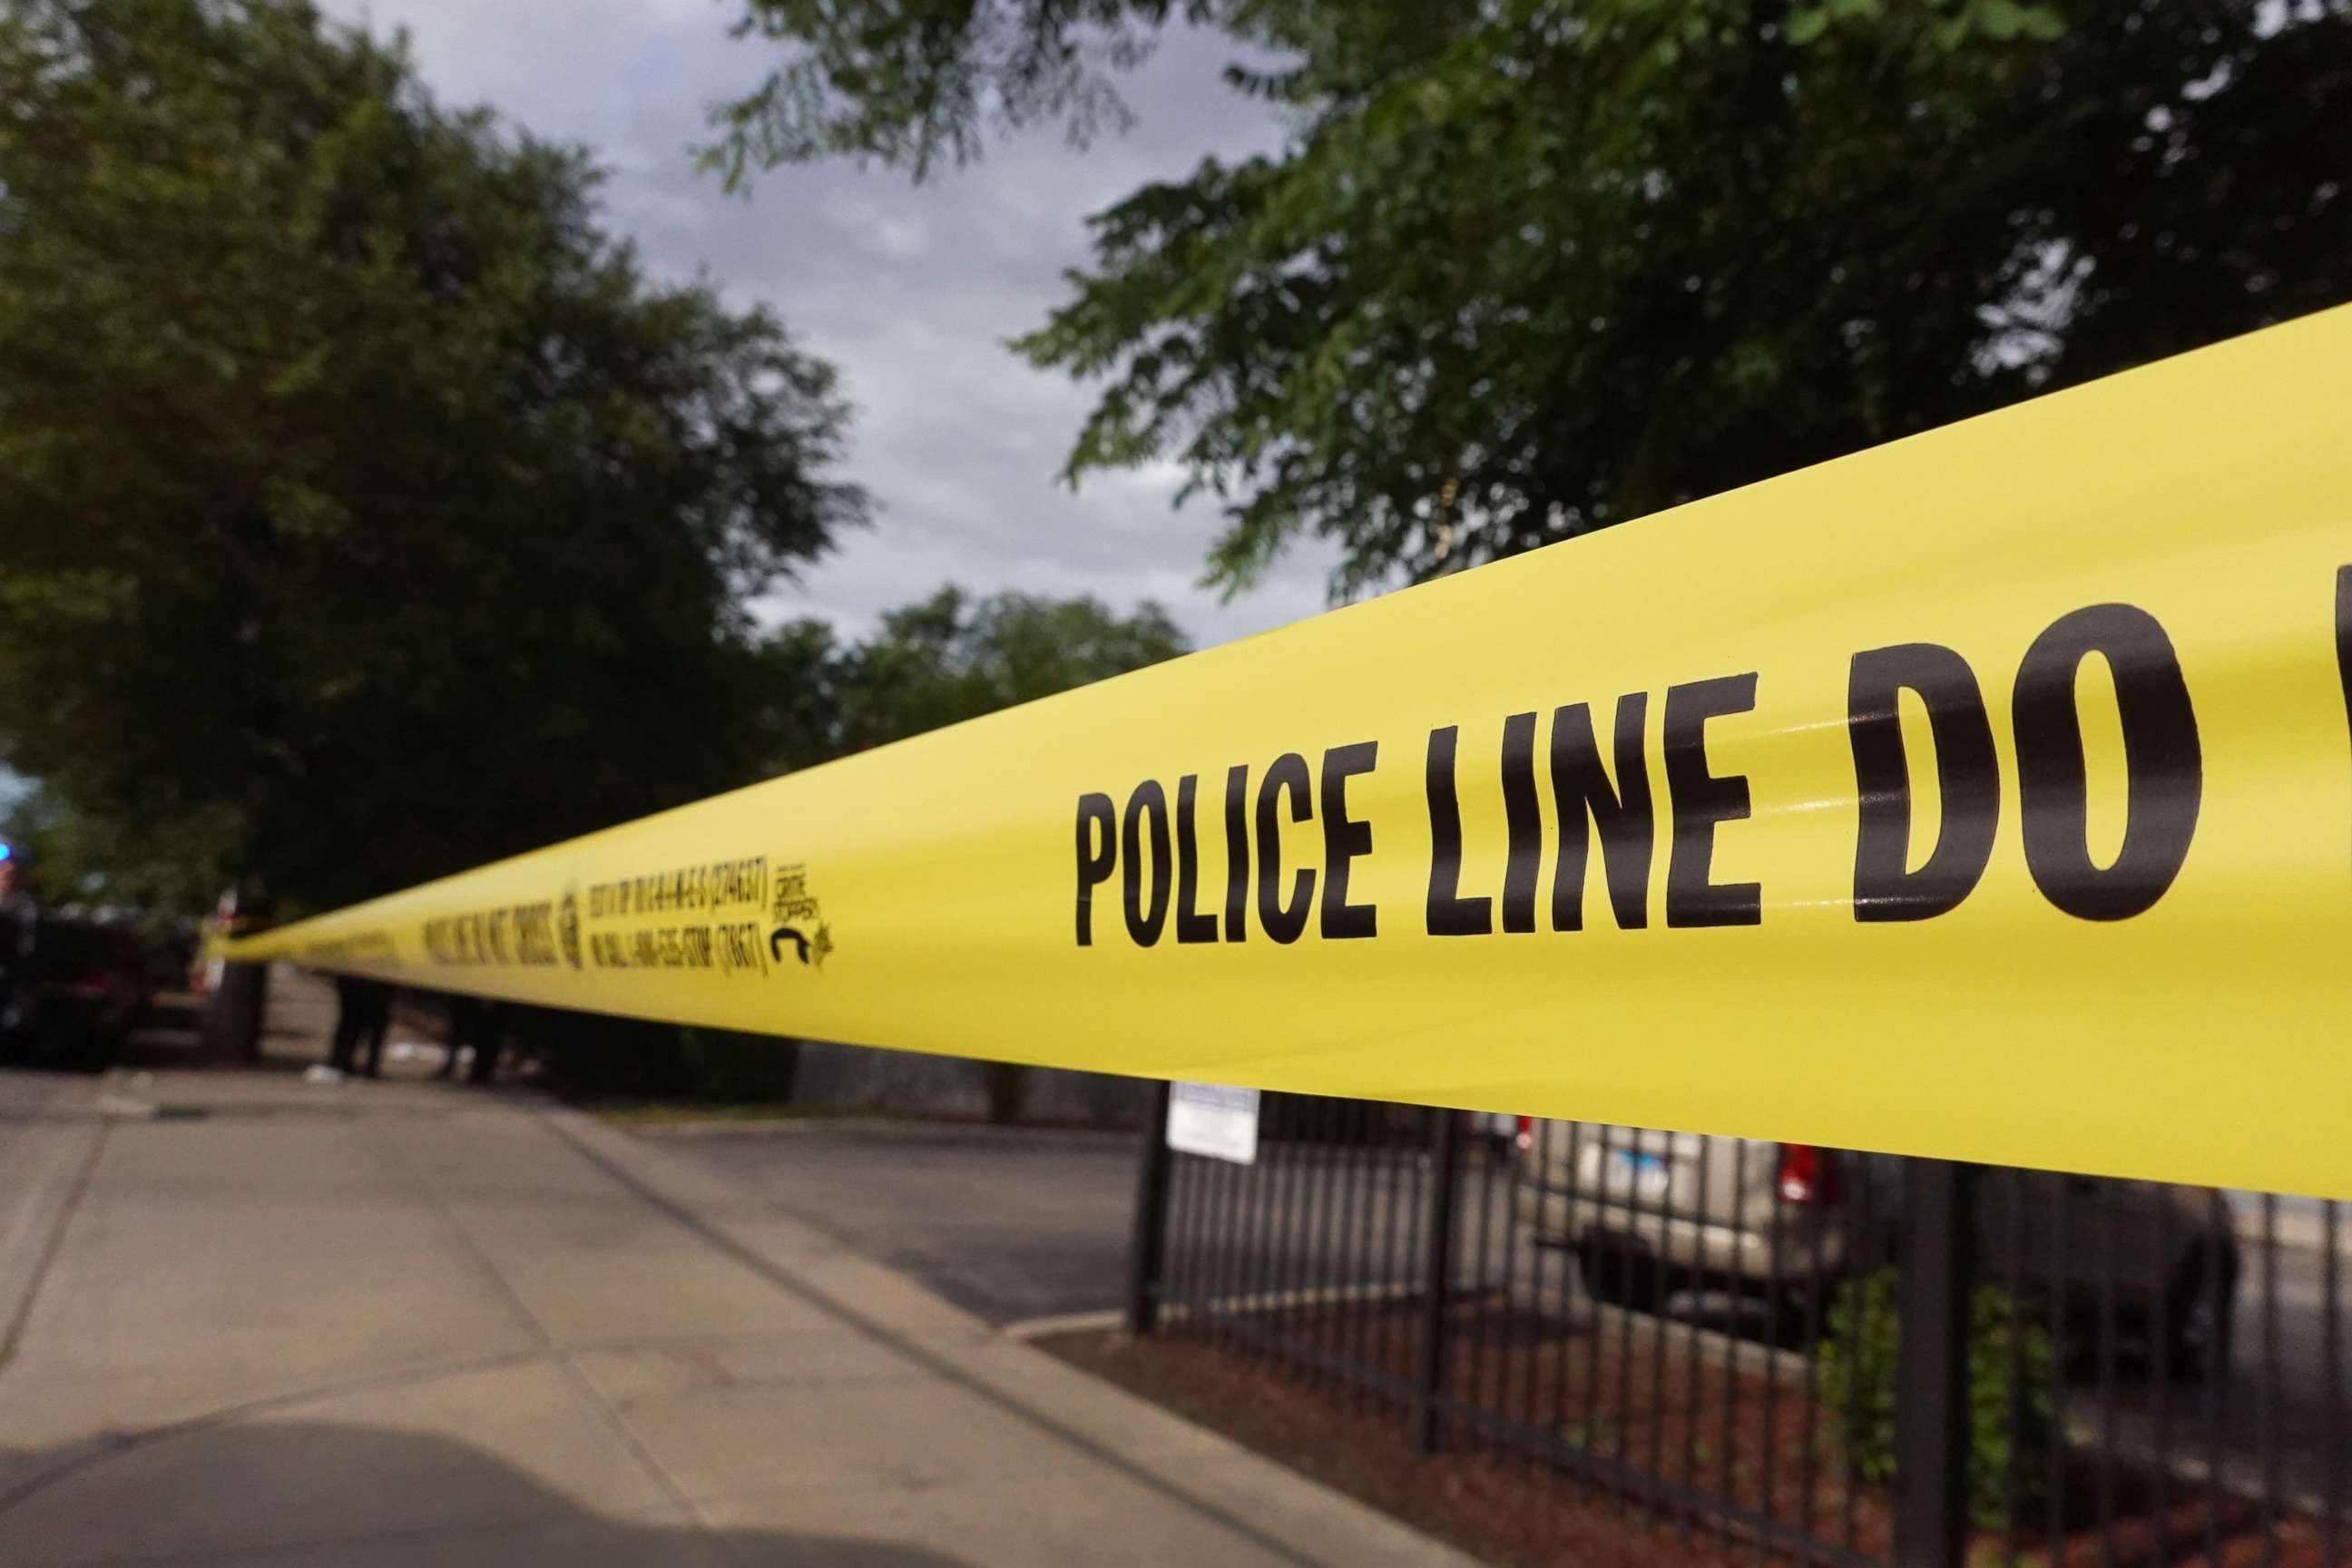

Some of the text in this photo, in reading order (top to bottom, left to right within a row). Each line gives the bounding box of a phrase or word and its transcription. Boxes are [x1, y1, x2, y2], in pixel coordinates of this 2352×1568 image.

[1075, 740, 1378, 947] POLICE
[1426, 671, 1762, 936] LINE
[1848, 603, 2202, 922] DO
